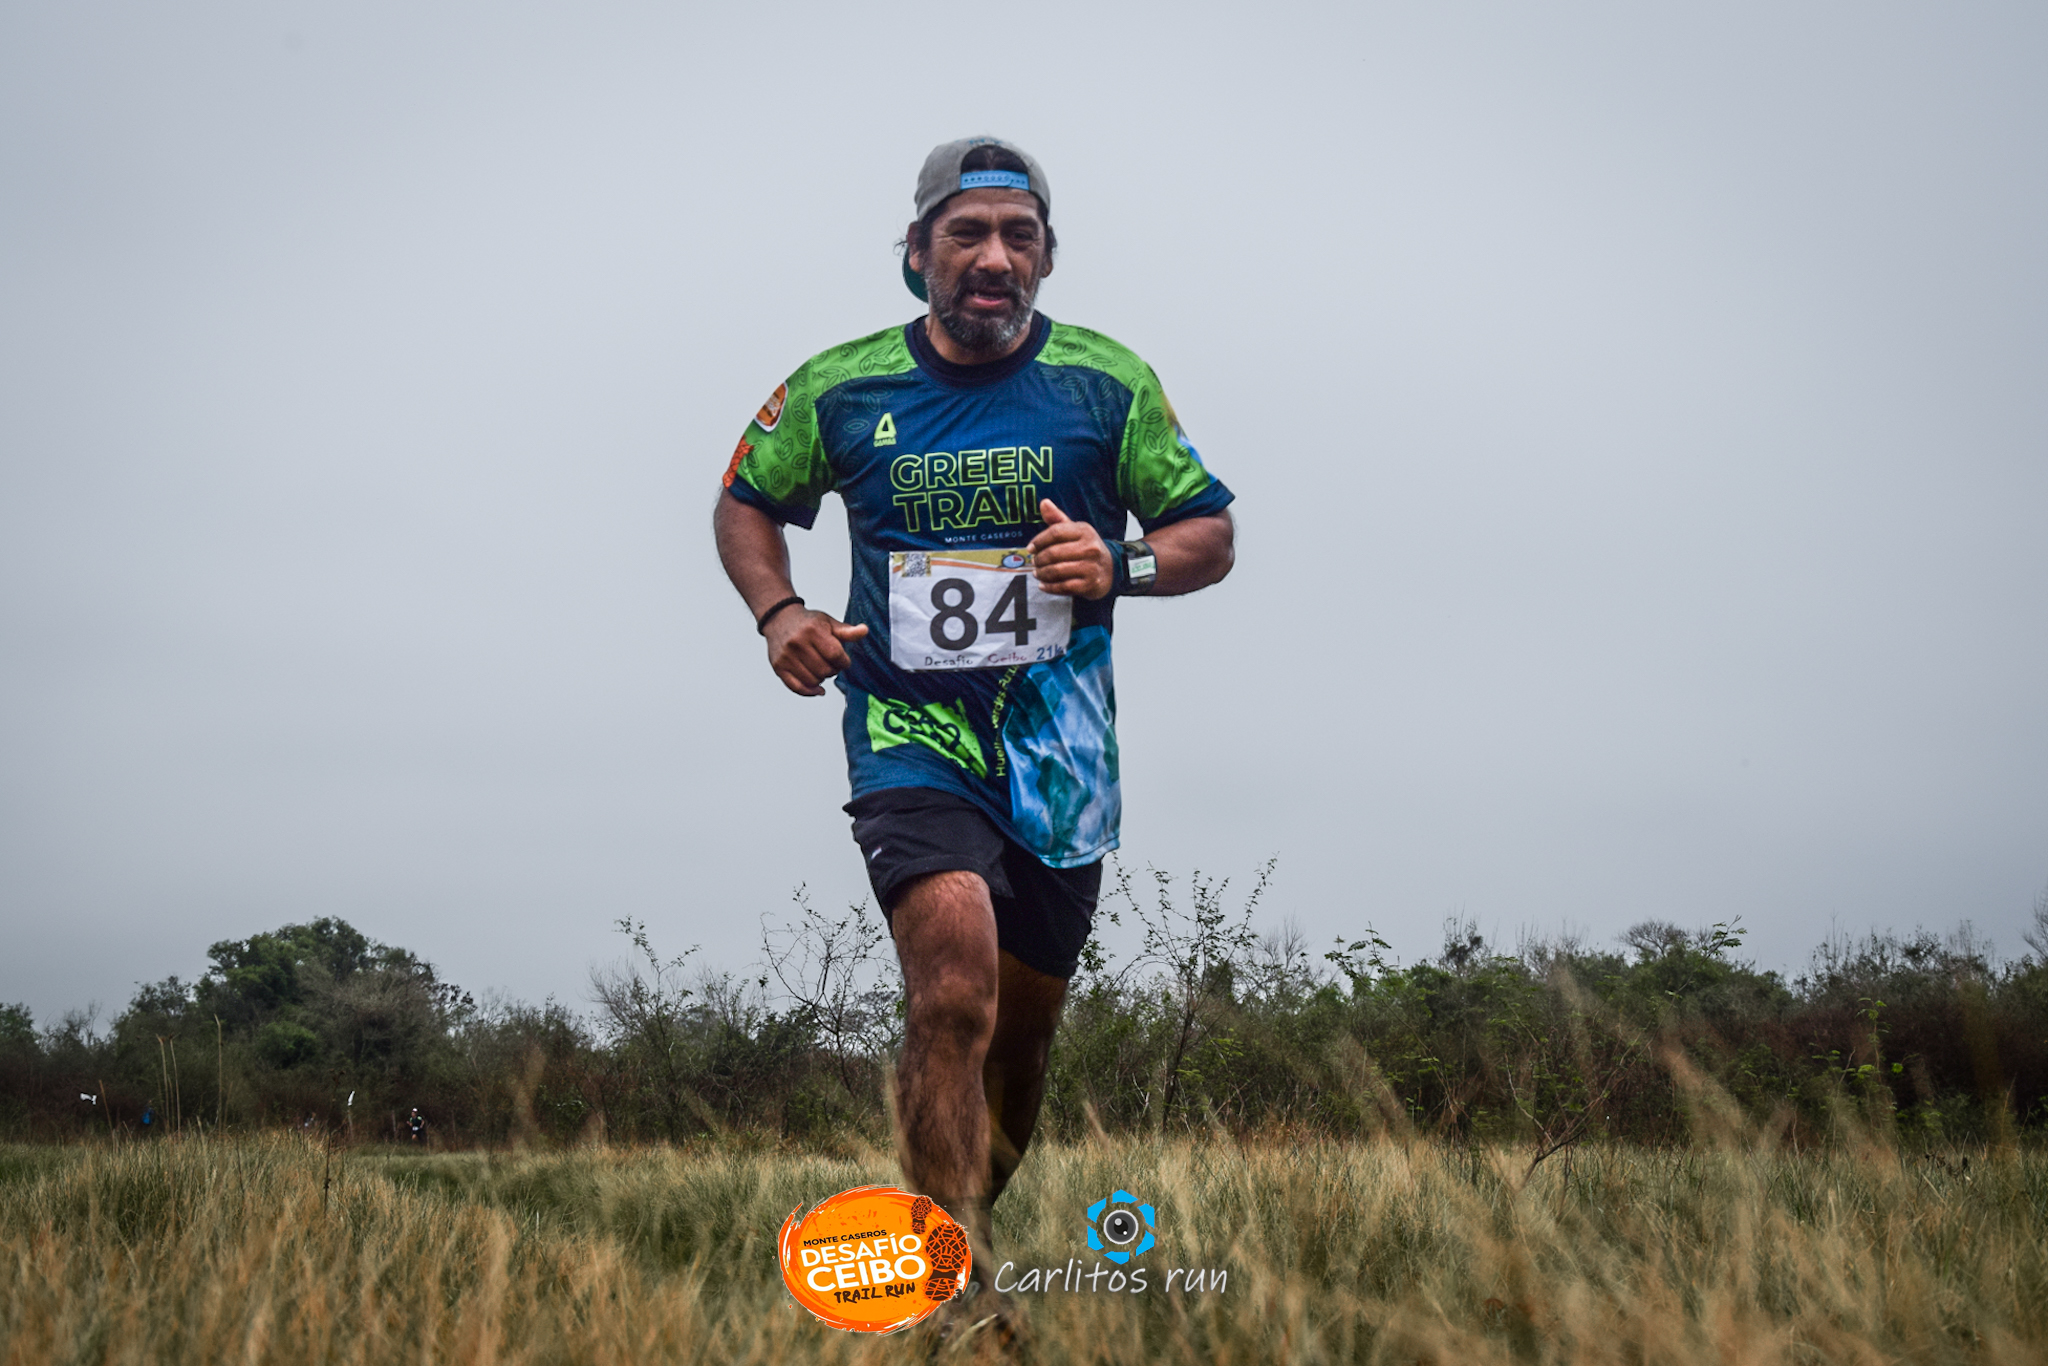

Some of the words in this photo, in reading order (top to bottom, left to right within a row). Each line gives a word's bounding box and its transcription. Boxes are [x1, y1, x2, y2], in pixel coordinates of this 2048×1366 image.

[890, 446, 1053, 492] GREEN
[892, 484, 1046, 532] TRAIL
[944, 534, 977, 543] MONTE
[980, 531, 1023, 541] CASEROS
[930, 574, 1037, 651] 84
